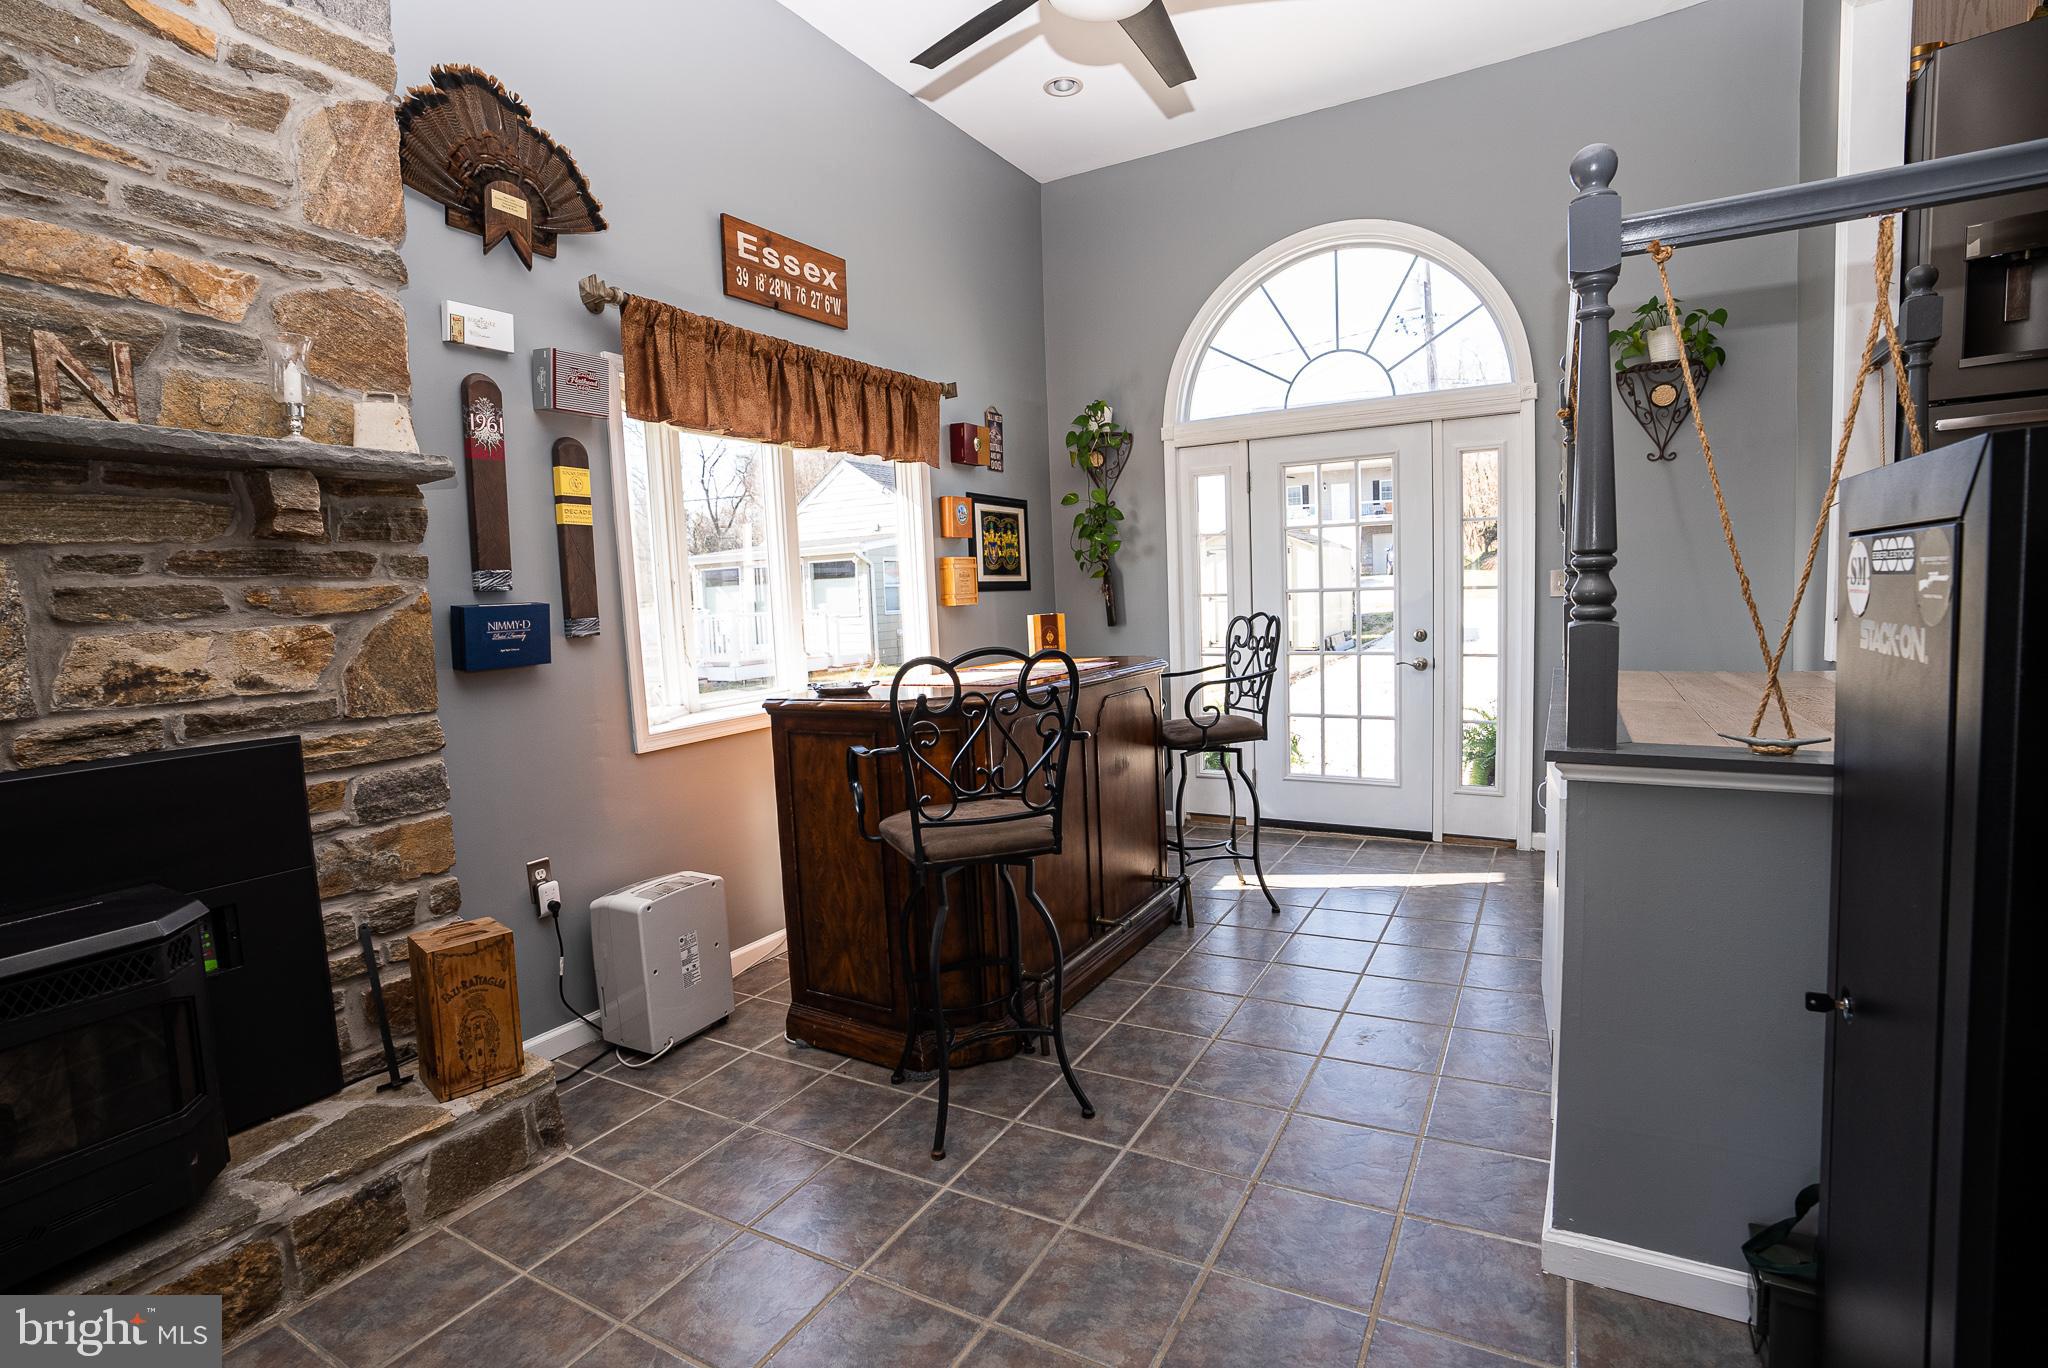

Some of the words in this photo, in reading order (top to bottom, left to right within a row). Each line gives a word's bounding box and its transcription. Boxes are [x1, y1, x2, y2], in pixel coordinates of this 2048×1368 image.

[736, 230, 839, 291] Essex
[735, 265, 749, 288] 39
[795, 285, 807, 306] 76
[470, 413, 504, 434] 1961
